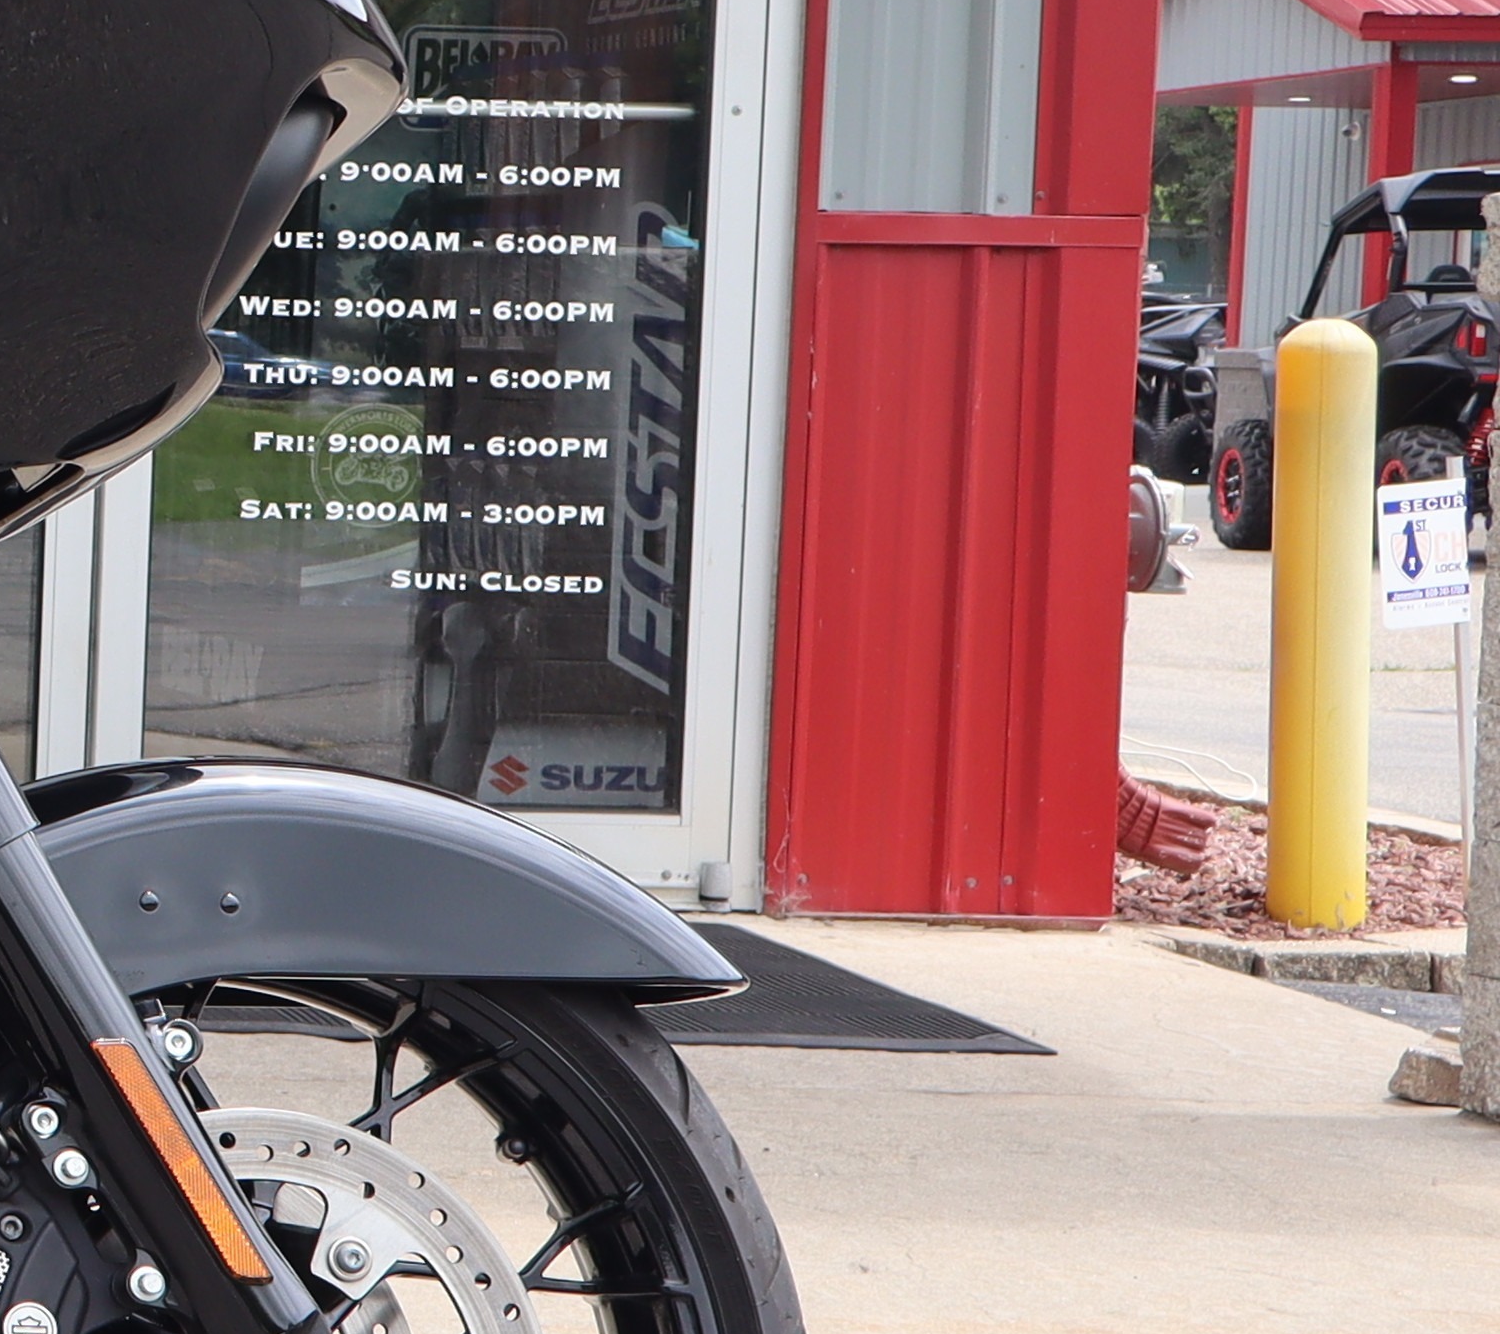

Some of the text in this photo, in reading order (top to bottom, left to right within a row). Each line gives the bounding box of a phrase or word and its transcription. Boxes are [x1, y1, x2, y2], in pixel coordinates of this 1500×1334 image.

[499, 164, 622, 188] 6:00PM
[273, 230, 326, 250] UE:
[337, 229, 461, 252] 9:00AM
[495, 232, 618, 256] 6:00PM
[334, 297, 458, 320] 9:00AM
[492, 300, 615, 323] 6:00PM
[331, 365, 455, 388] 9:00AM
[489, 369, 612, 391] 6:00PM
[328, 433, 452, 455] 9:00AM
[486, 436, 609, 459] 6:00PM
[325, 501, 449, 523] 9:00AM
[483, 504, 606, 526] 3:00PM
[1435, 562, 1462, 574] LOCK
[480, 571, 604, 594] CLOSED
